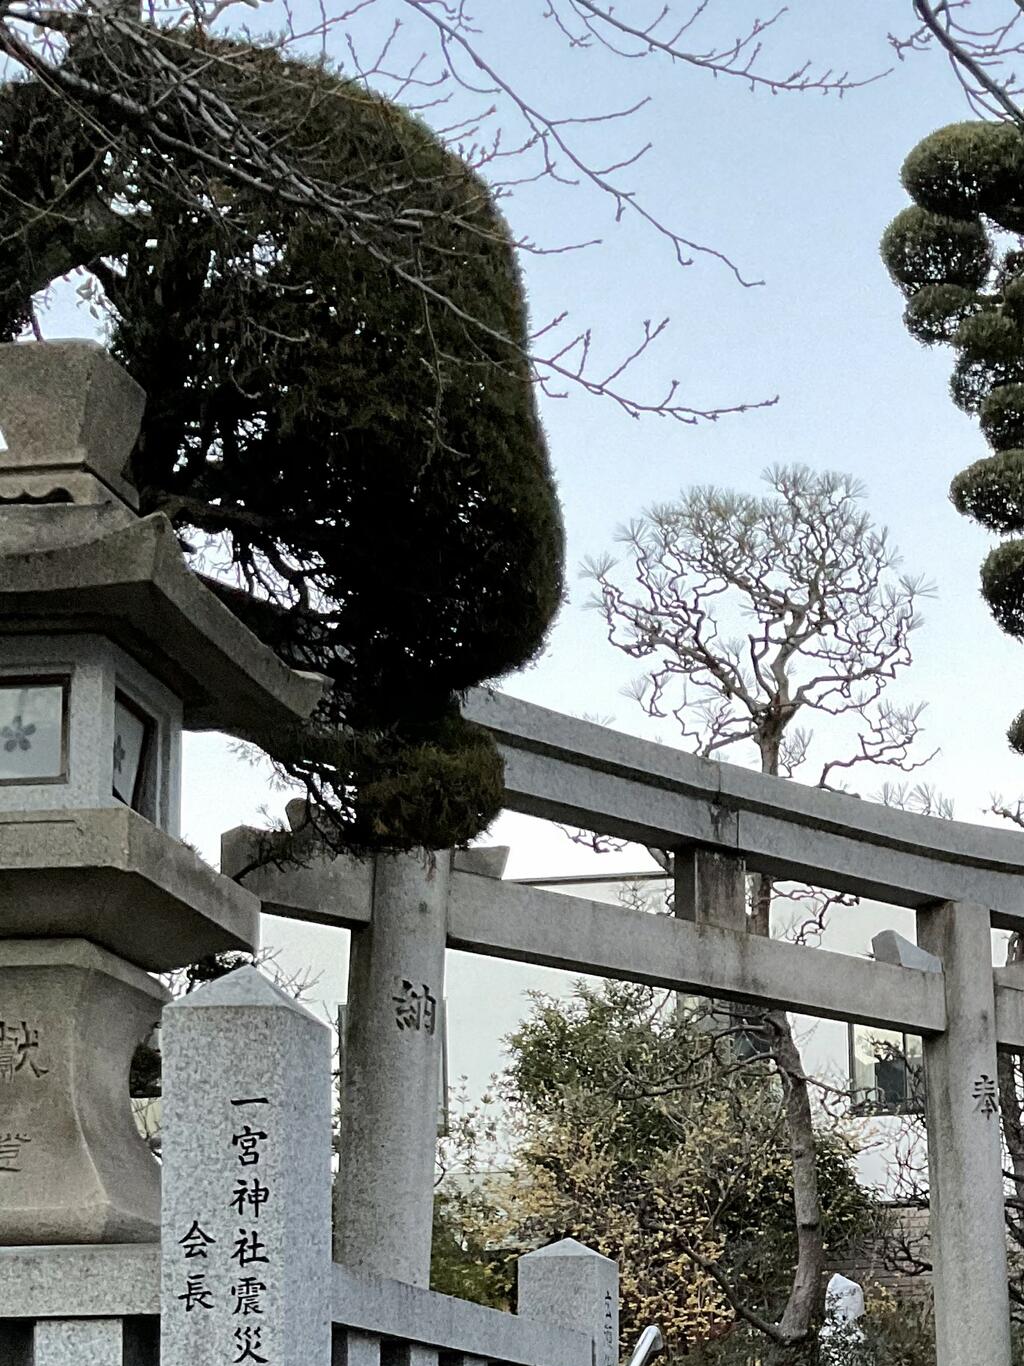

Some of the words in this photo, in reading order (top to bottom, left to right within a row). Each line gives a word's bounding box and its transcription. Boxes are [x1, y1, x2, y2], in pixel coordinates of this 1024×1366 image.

[392, 980, 436, 1035] 納
[972, 1075, 997, 1120] 奉
[177, 1220, 216, 1312] 会長
